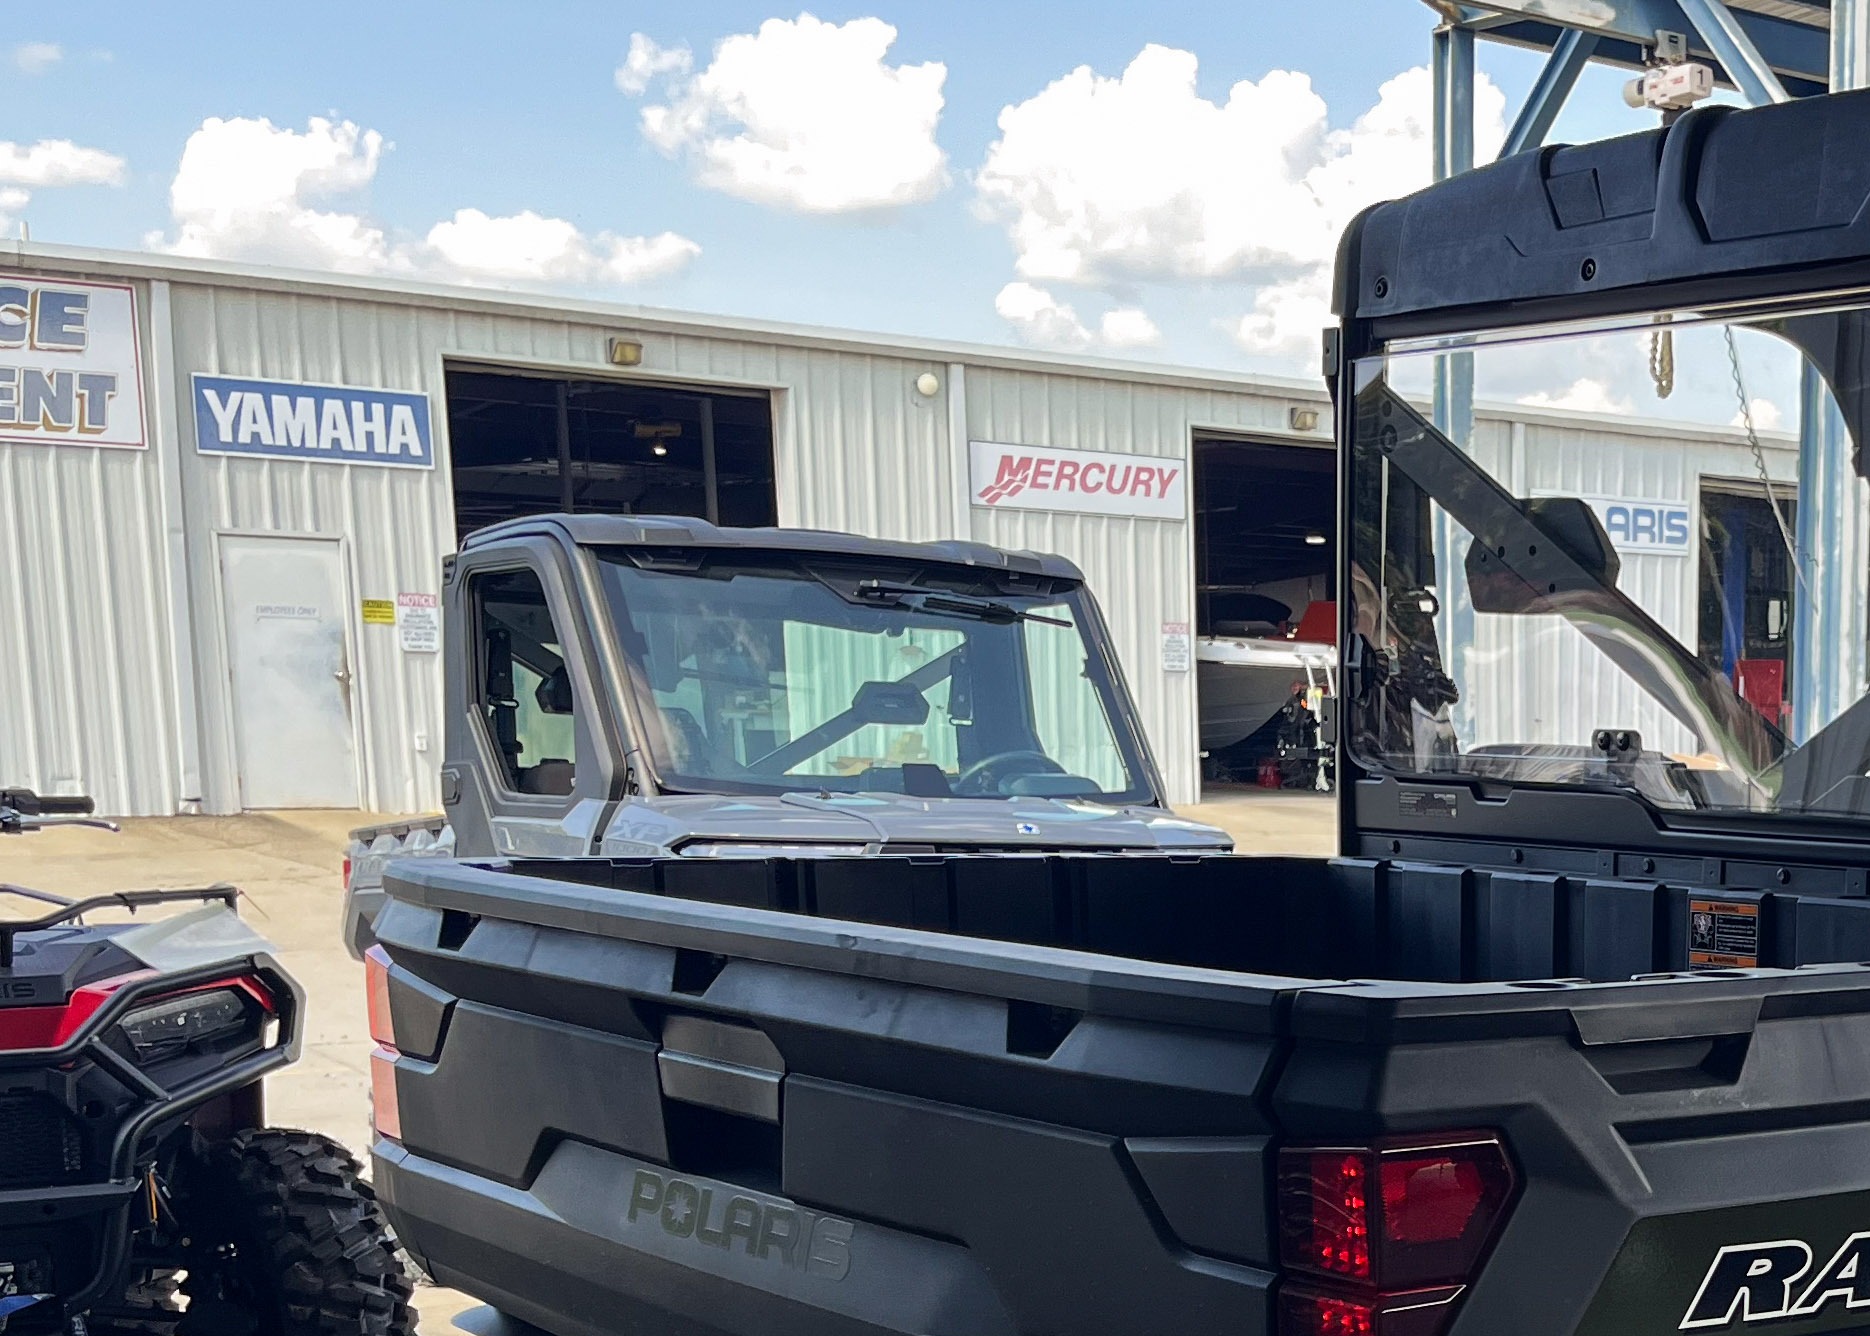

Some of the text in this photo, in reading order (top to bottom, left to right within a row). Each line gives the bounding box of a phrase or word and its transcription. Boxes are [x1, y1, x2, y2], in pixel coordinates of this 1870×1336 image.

[202, 388, 423, 457] YAMAHA
[988, 455, 1179, 500] MERCURY
[1606, 506, 1688, 545] ARIS
[399, 592, 436, 607] NOTICE
[627, 1168, 856, 1284] POLARIS
